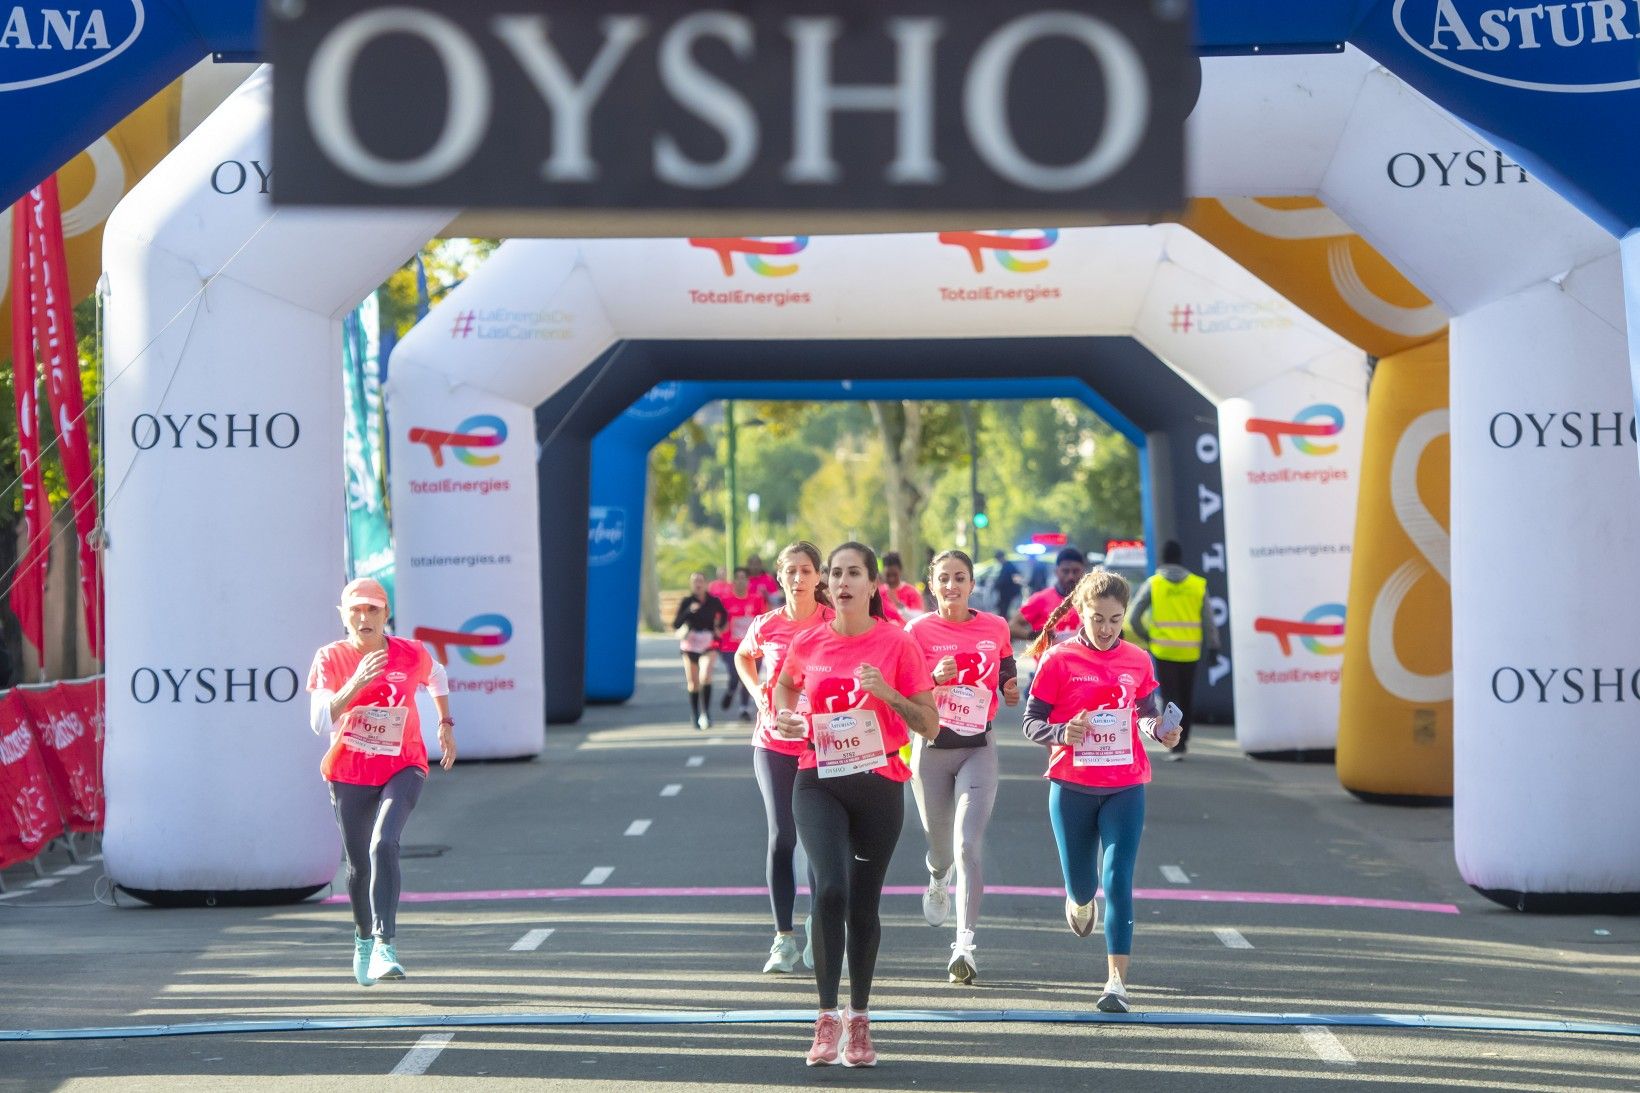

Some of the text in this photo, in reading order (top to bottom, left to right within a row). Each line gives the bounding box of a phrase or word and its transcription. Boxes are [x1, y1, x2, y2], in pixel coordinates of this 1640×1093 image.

[1, 6, 111, 50] ANA
[303, 5, 1151, 190] OYSHO
[688, 288, 811, 307] TotalEnergies
[938, 285, 1062, 302] TotalEnergies
[131, 412, 300, 450] OYSHO
[1246, 467, 1349, 485] TotalEnergies
[409, 479, 511, 495] TotalEnergies
[410, 555, 512, 568] totalenergies.es
[1195, 432, 1231, 687] VOLVO
[130, 665, 299, 704] OYSHO
[949, 703, 970, 715] 016
[364, 723, 386, 734] 016
[834, 737, 860, 750] 016
[1094, 733, 1116, 743] 016
